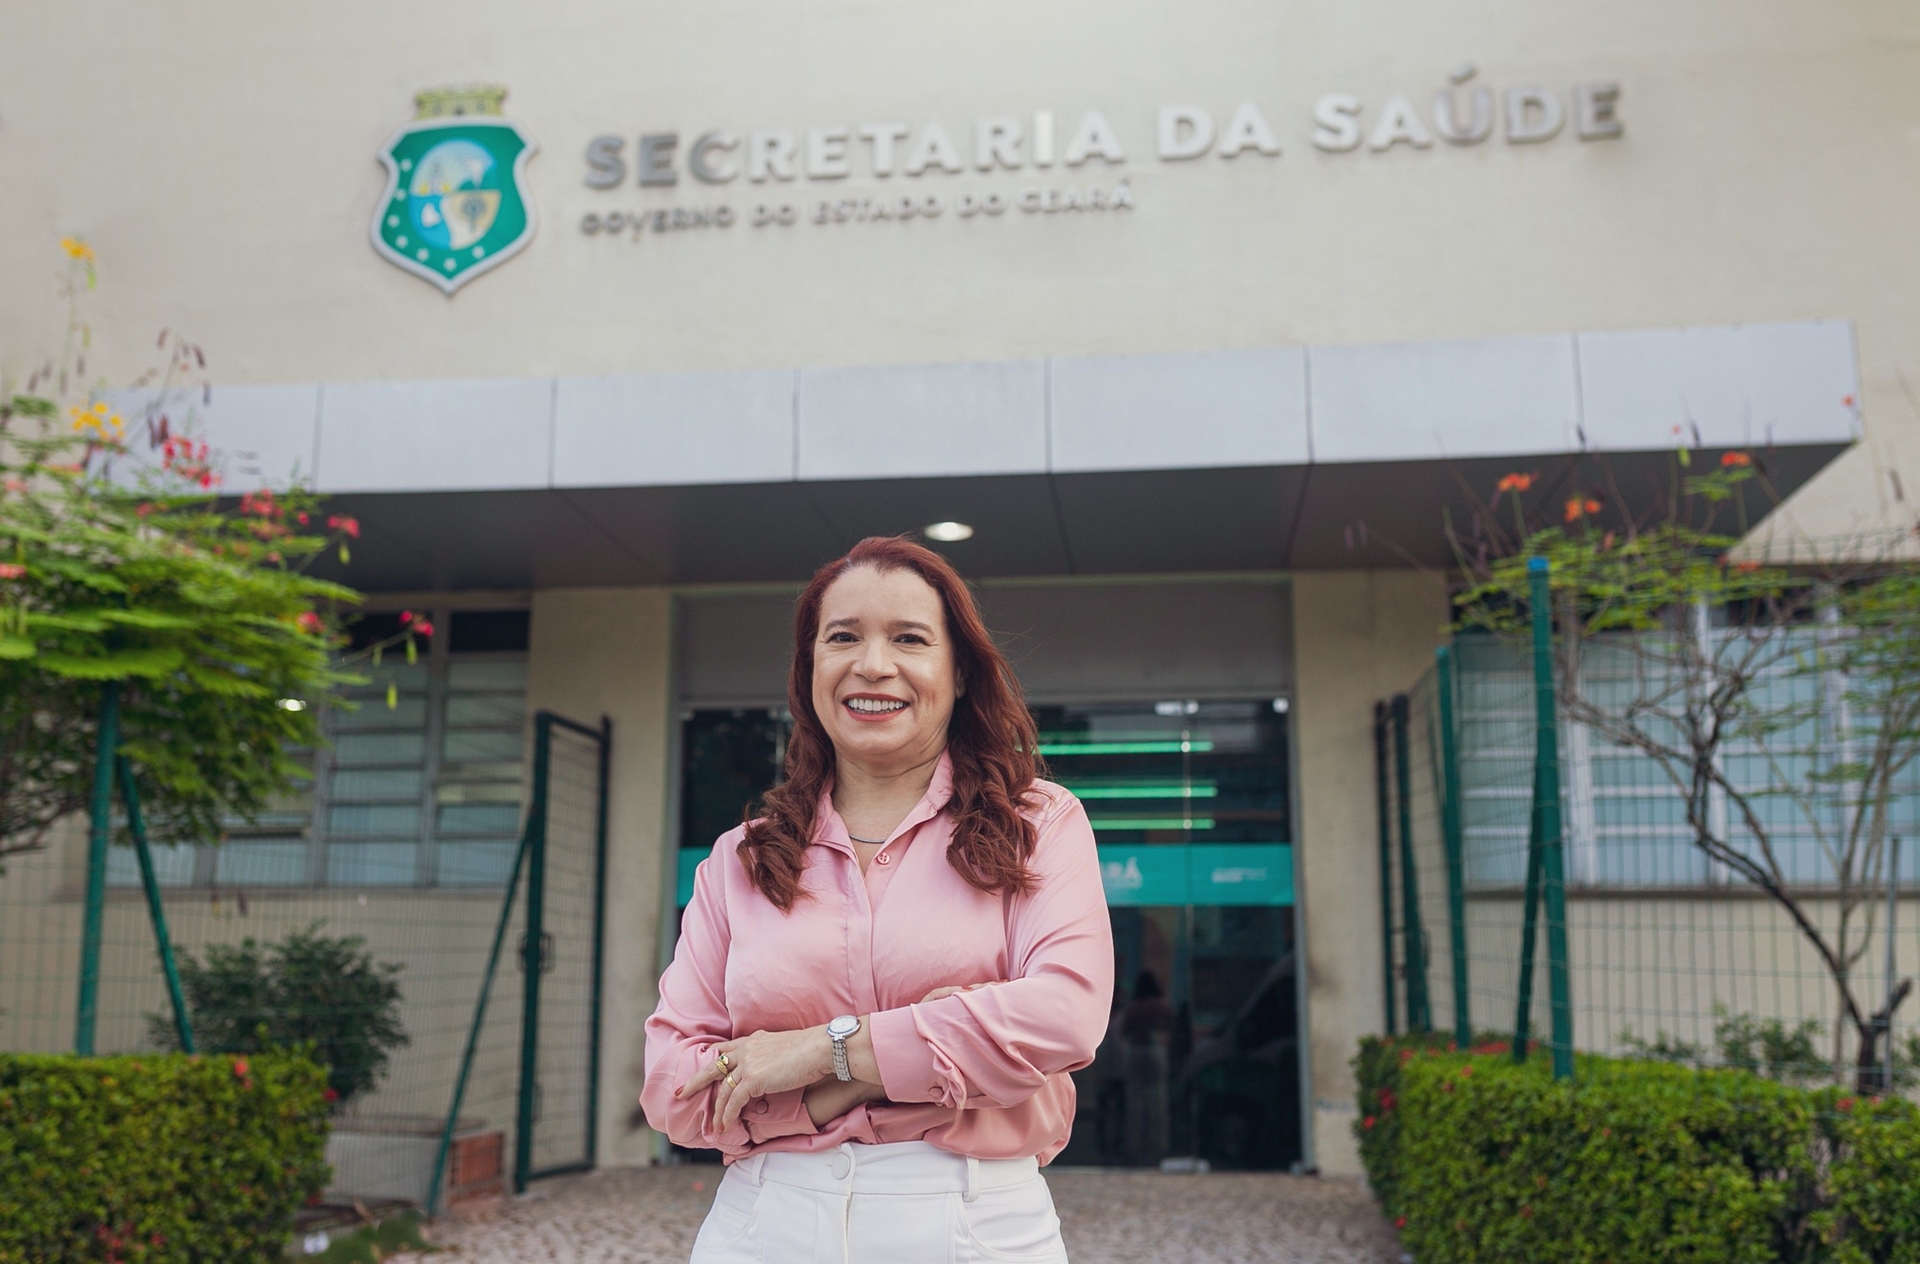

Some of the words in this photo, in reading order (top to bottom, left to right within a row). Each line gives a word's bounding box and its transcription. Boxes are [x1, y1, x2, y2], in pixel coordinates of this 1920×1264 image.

[584, 109, 1125, 189] SECRETARIA
[1156, 101, 1280, 161] DA
[1311, 63, 1624, 153] SAÚDE
[580, 206, 735, 237] GOVERNO
[751, 200, 798, 228] DO
[813, 195, 943, 226] ESTADO
[957, 193, 1007, 218] DO
[1016, 180, 1135, 214] CEARÁ
